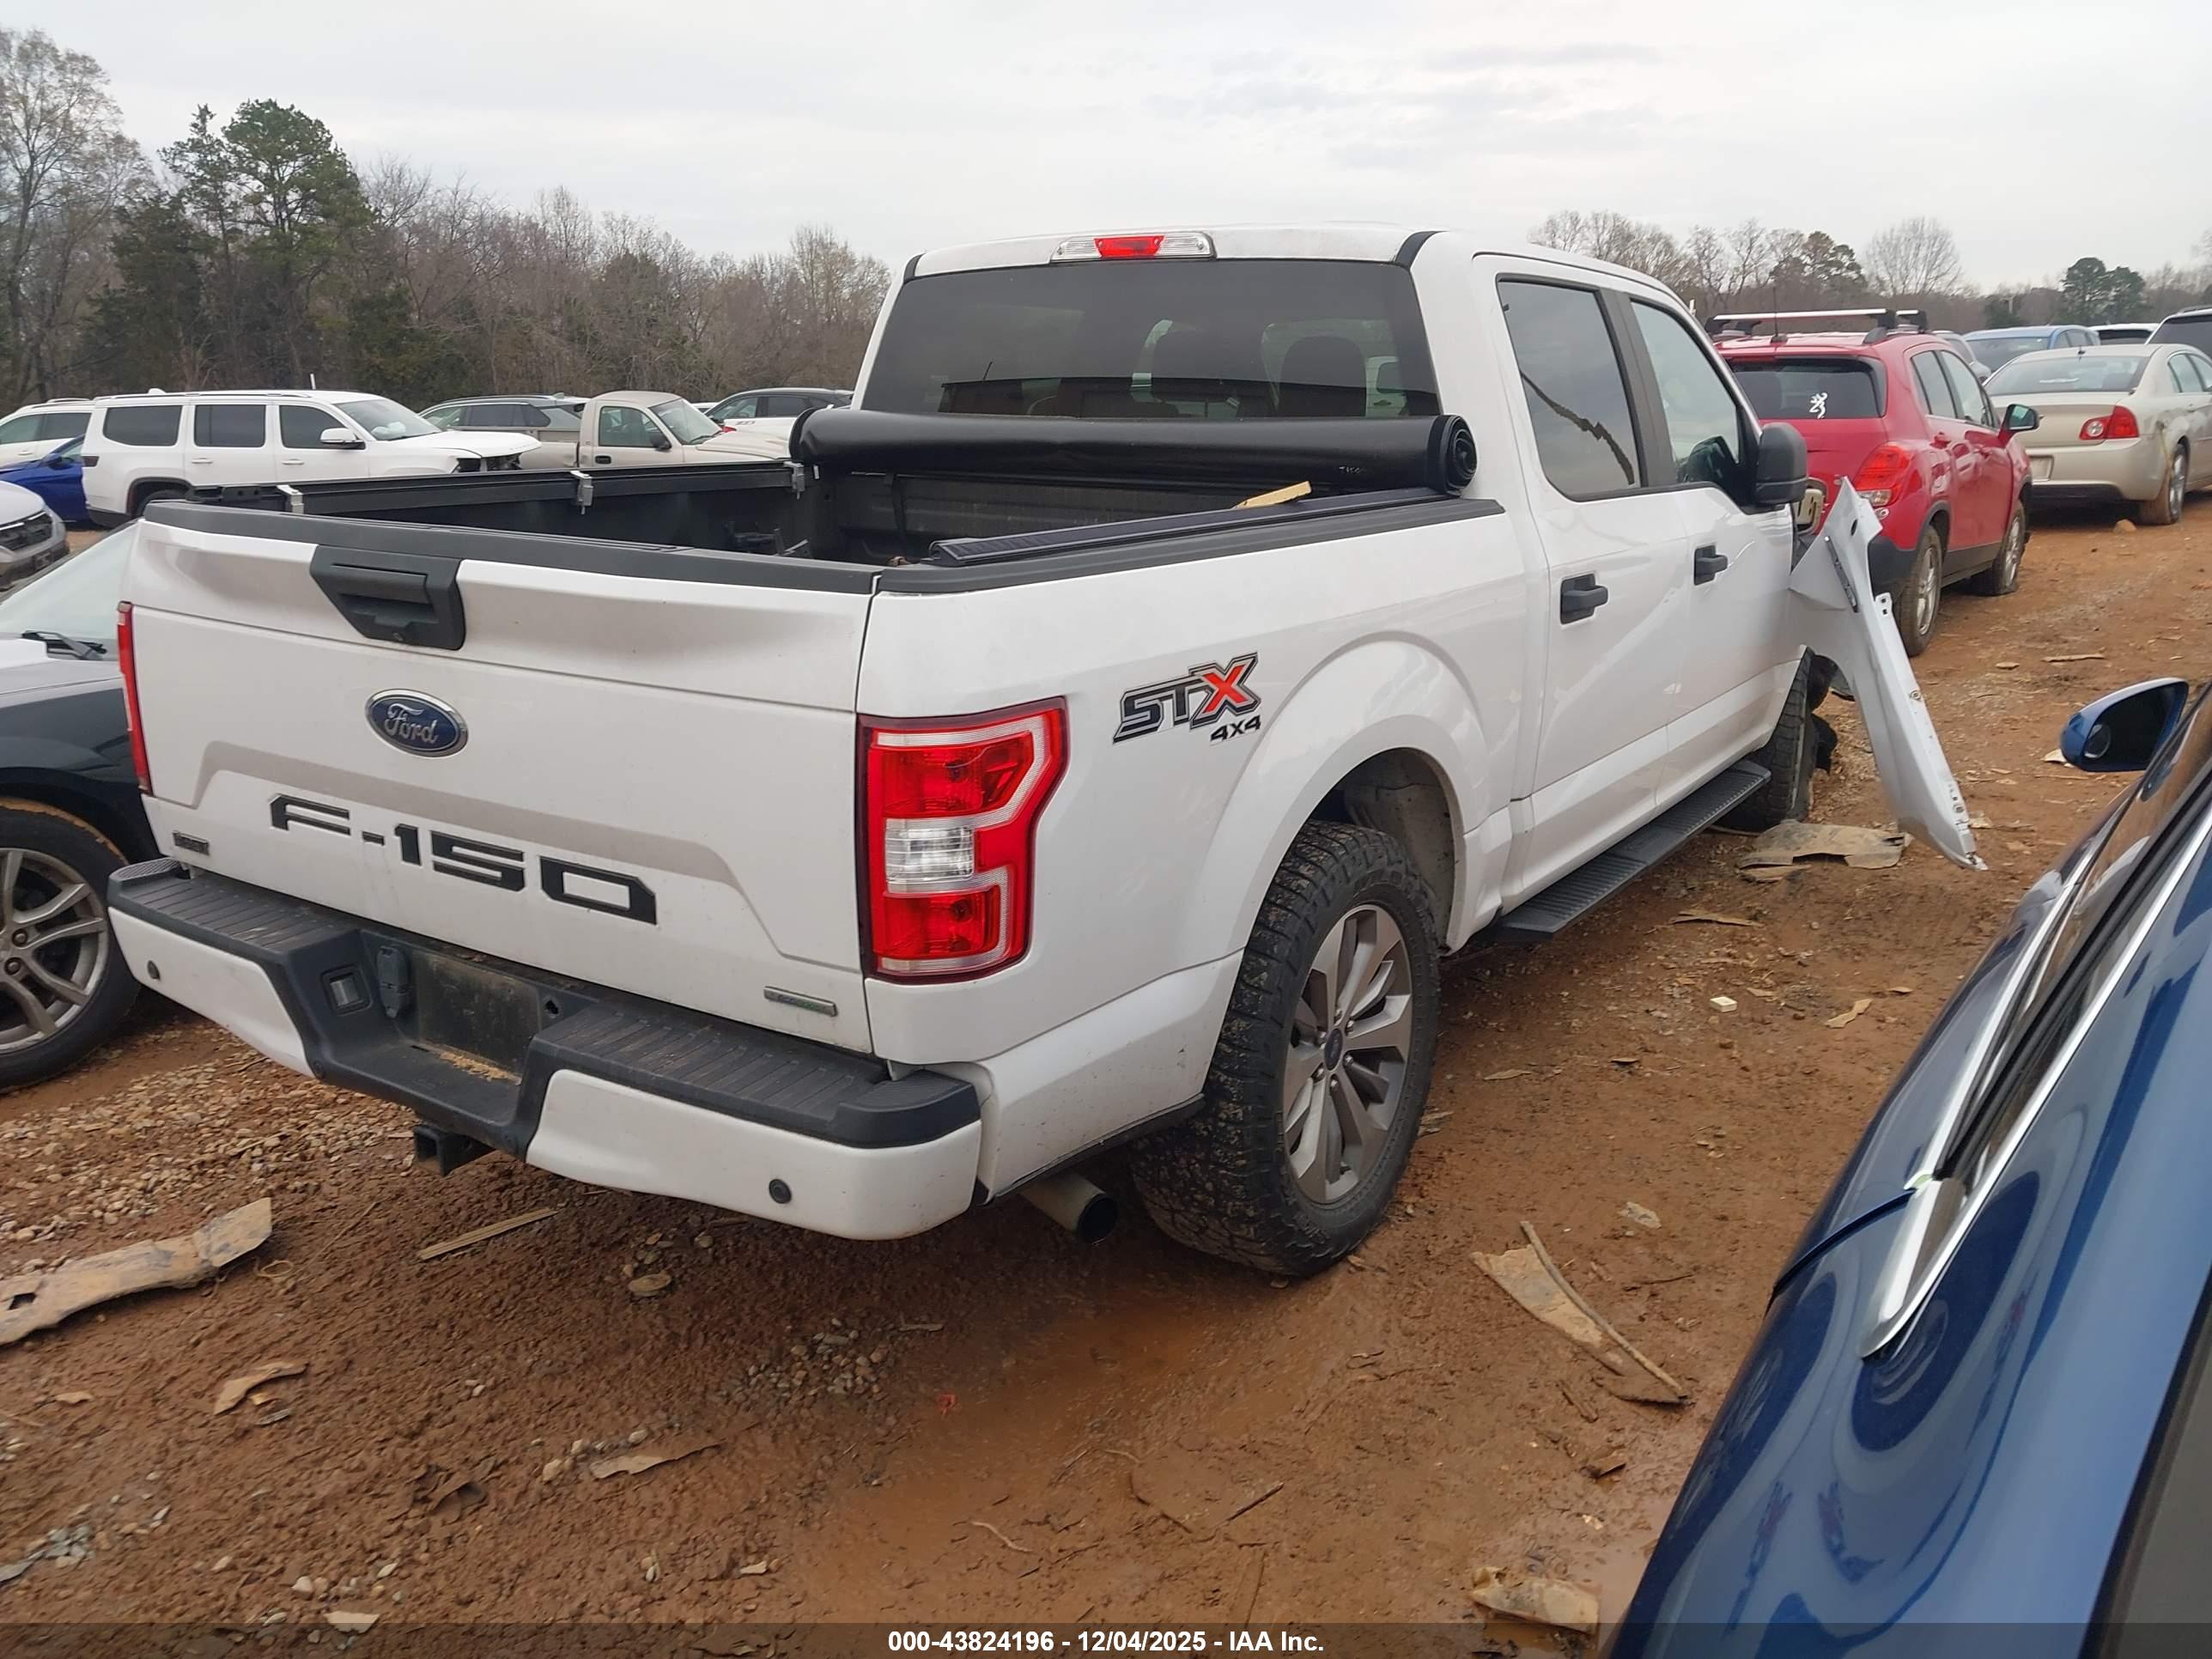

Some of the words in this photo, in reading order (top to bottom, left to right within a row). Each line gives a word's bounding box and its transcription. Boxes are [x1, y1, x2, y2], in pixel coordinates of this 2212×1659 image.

[384, 702, 439, 744] Ford
[1112, 652, 1261, 744] STX
[270, 794, 658, 926] F-150
